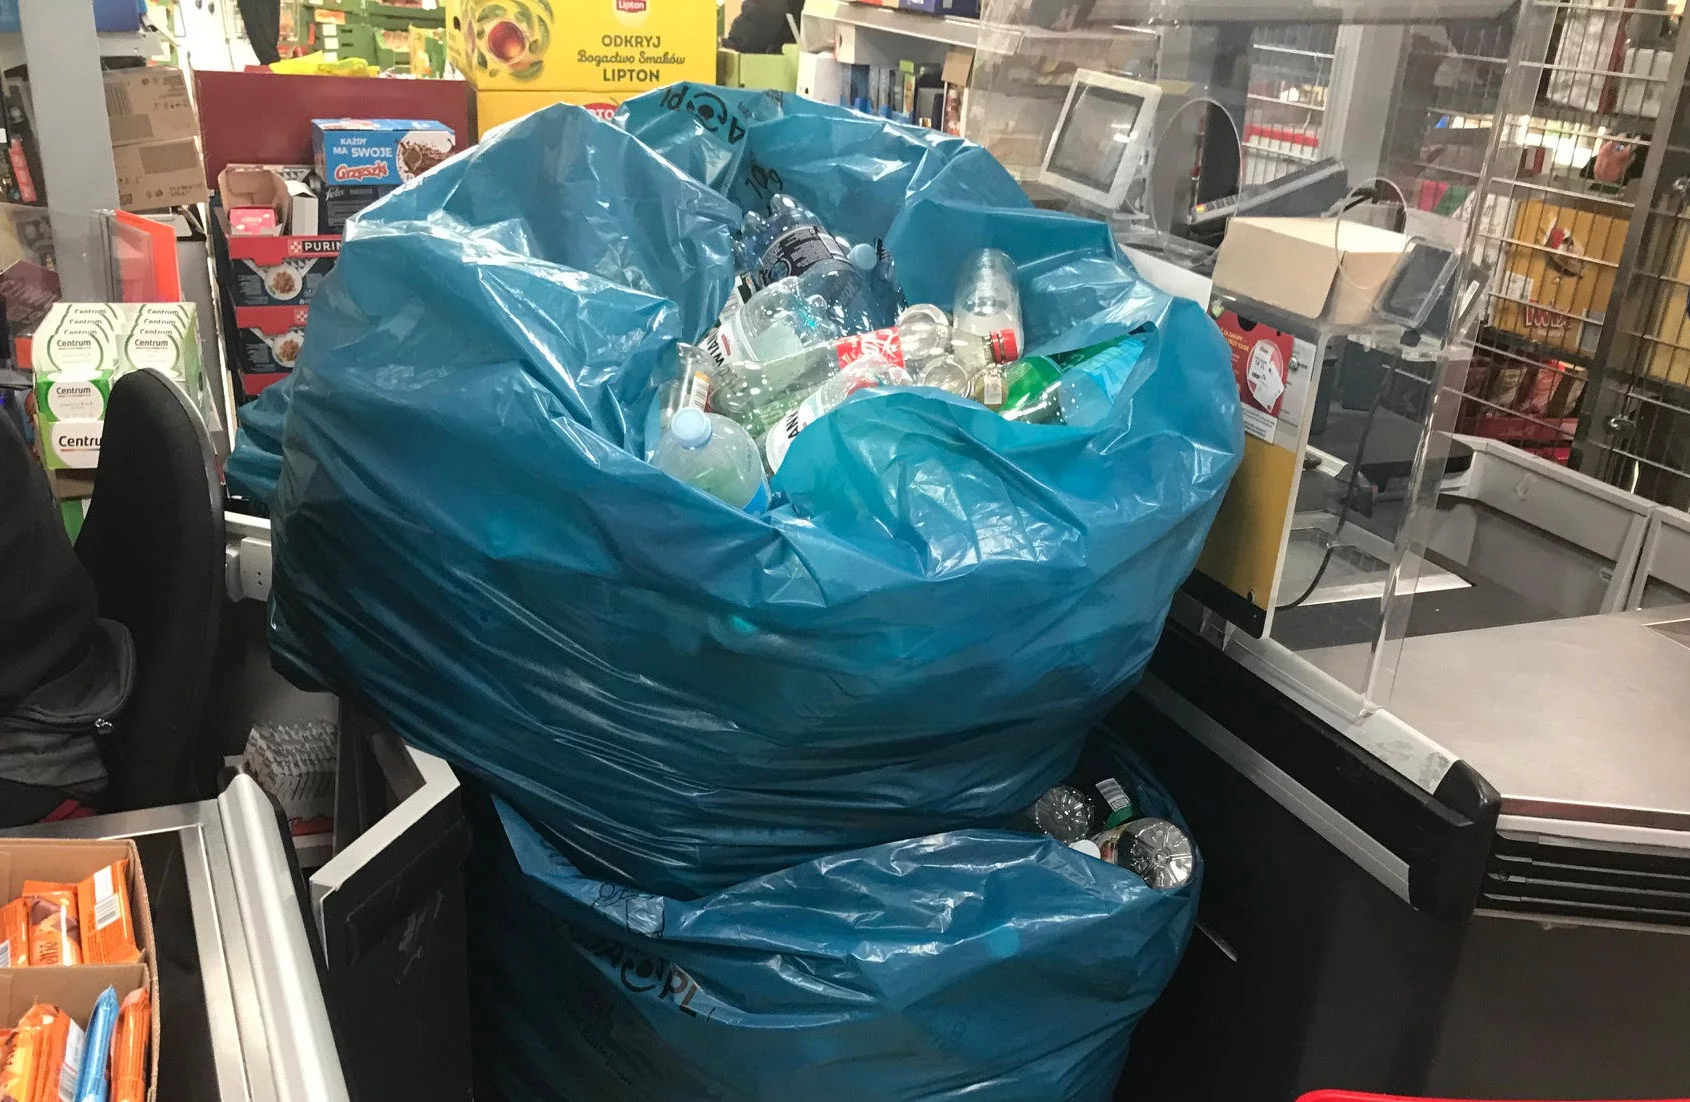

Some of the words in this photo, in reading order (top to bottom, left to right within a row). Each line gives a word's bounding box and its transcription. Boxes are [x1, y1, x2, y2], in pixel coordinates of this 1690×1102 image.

[601, 34, 661, 48] ODKRYJ
[577, 49, 636, 67] Bogactwo
[638, 51, 686, 64] Smaków
[602, 69, 660, 82] LIPTON
[351, 147, 393, 158] SWOJE
[56, 339, 91, 347] Centrum
[134, 338, 168, 347] Centrum
[56, 386, 91, 395] Centrum
